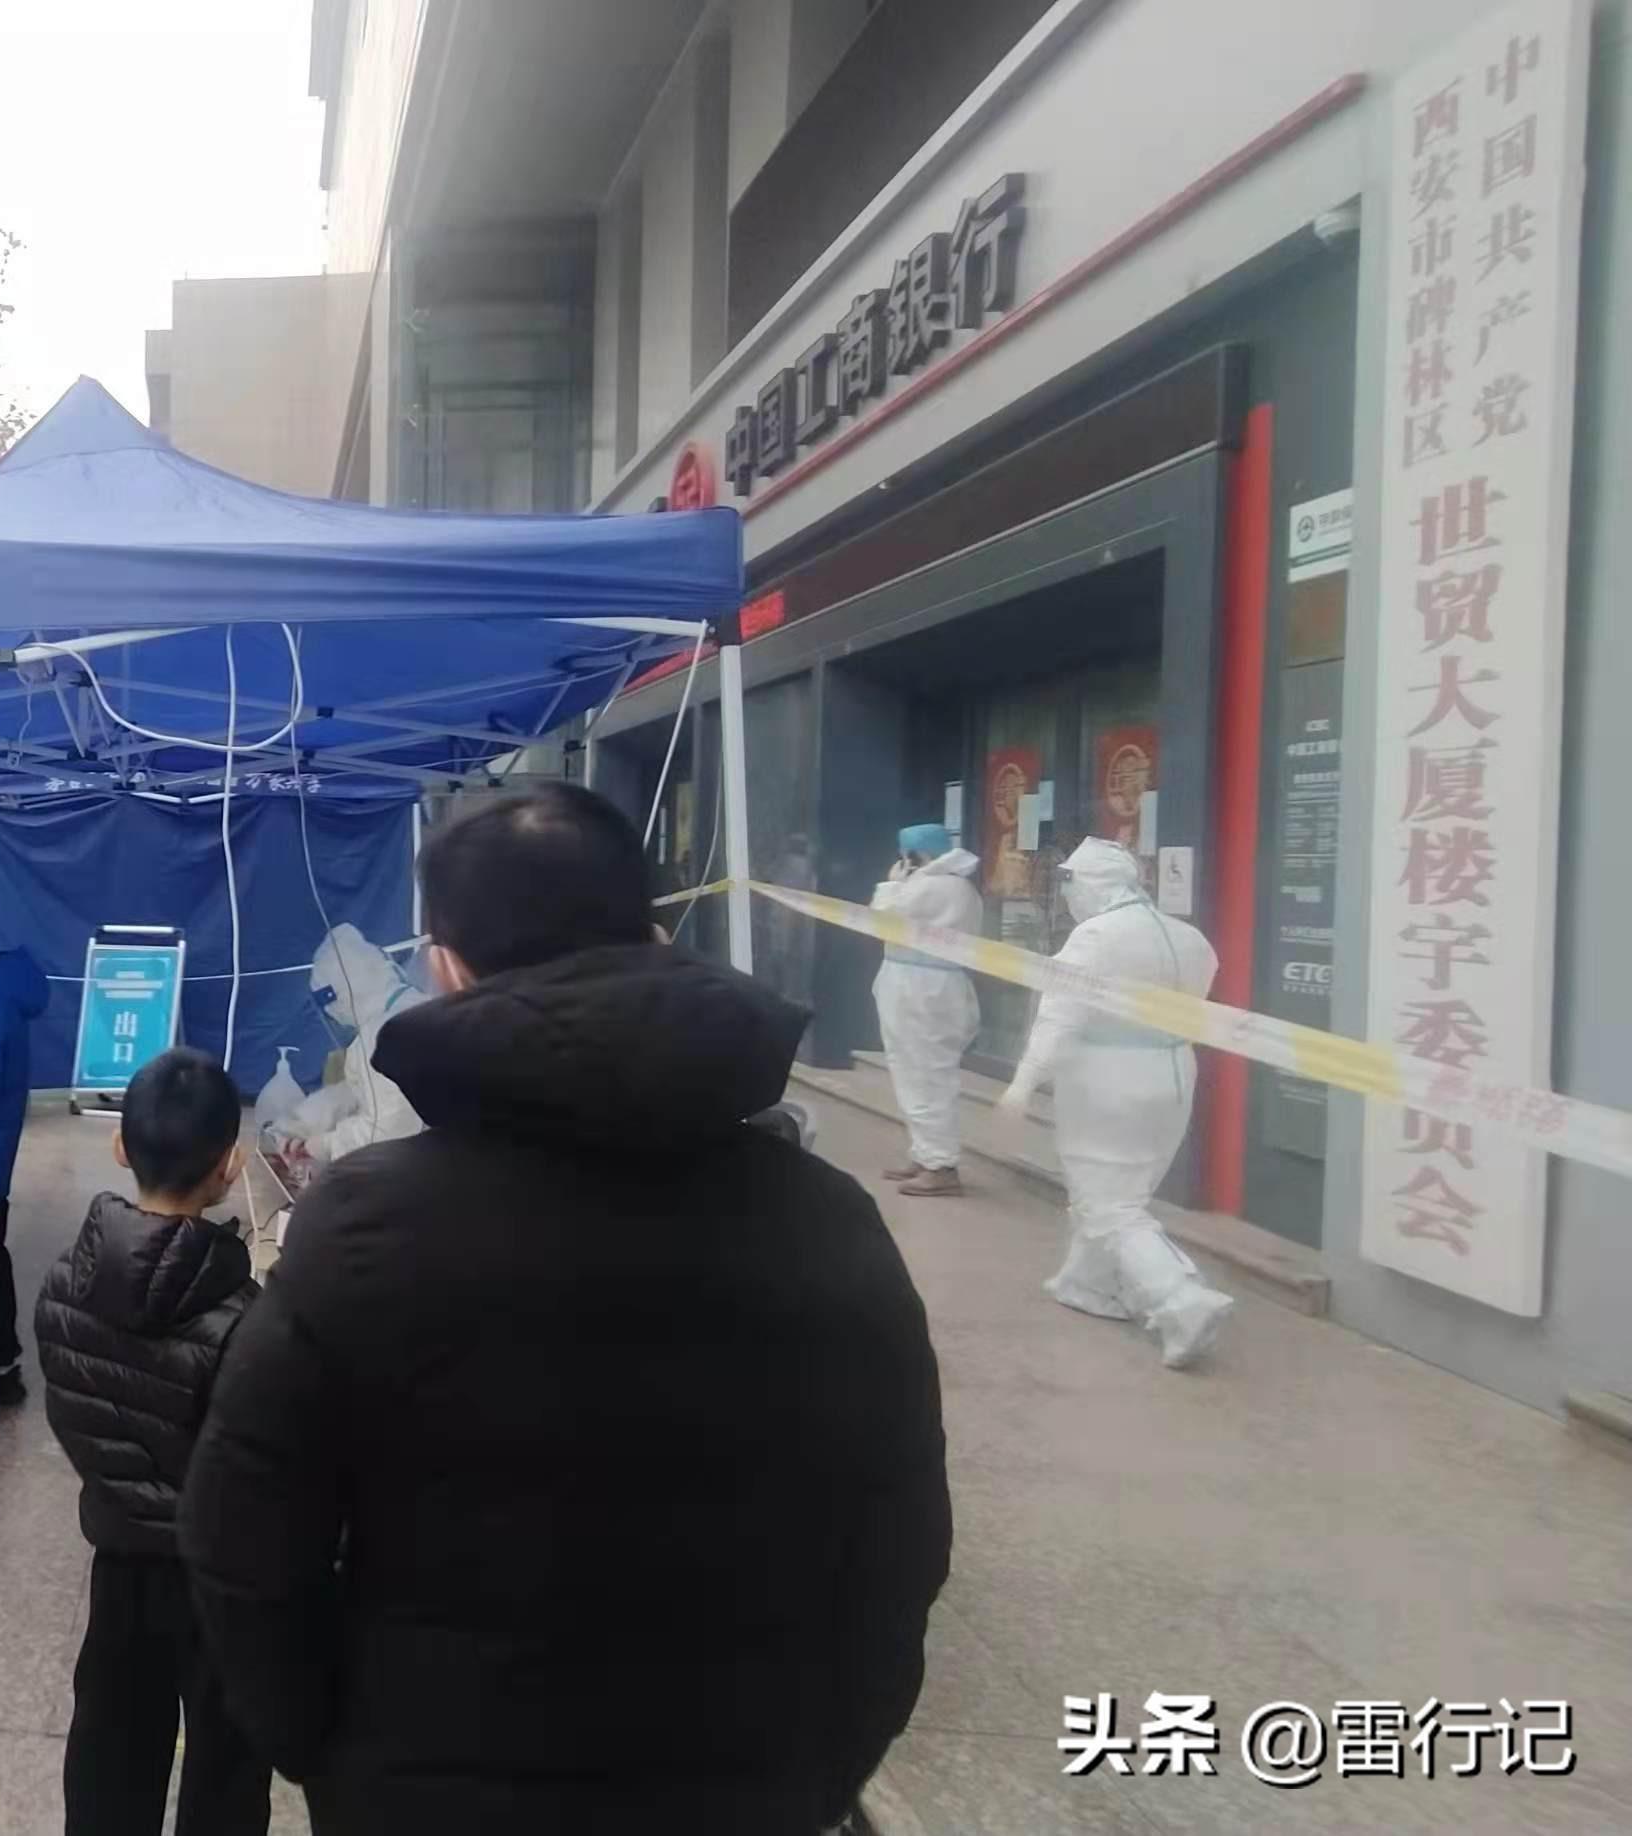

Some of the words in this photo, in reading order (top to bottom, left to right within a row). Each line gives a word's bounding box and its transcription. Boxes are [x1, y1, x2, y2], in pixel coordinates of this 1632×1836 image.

[725, 172, 1027, 496] 中国工商银行
[1402, 76, 1463, 469] 西安市碑林区
[1472, 34, 1540, 448] 中国共产党
[112, 1011, 138, 1063] 出口
